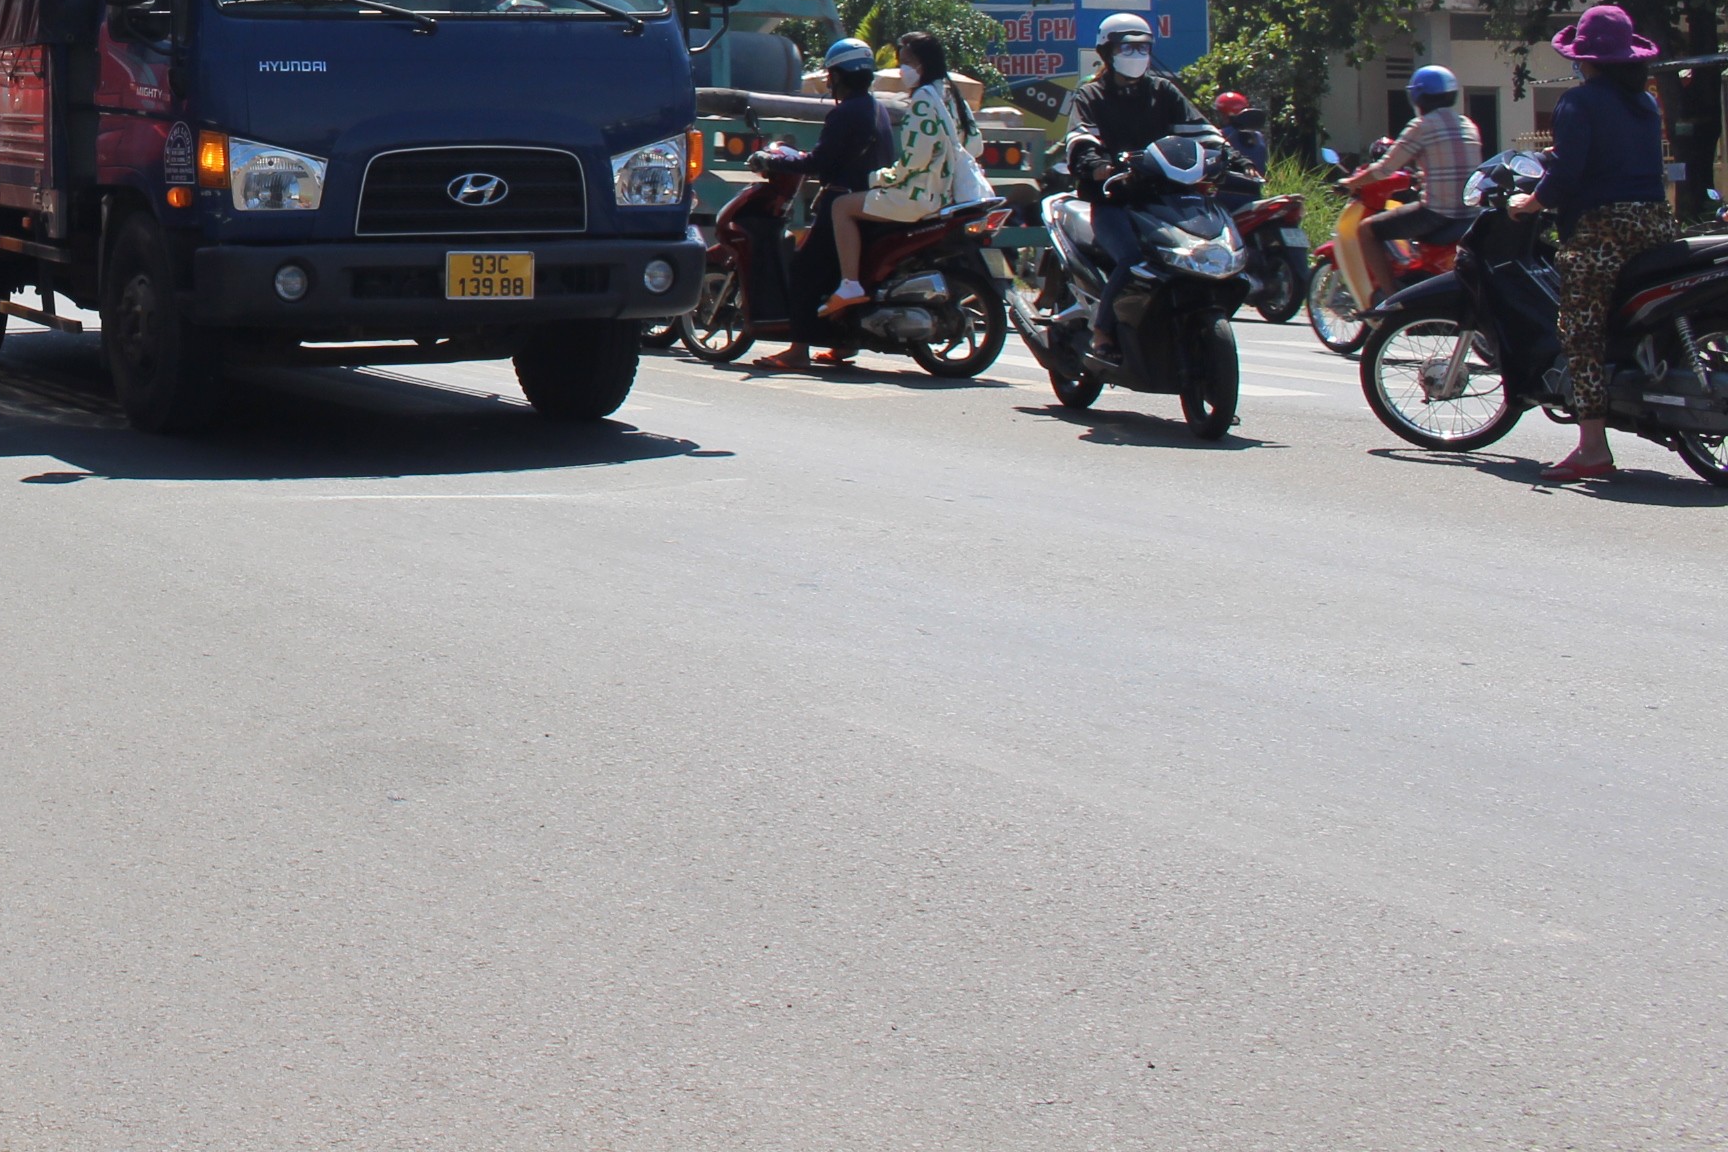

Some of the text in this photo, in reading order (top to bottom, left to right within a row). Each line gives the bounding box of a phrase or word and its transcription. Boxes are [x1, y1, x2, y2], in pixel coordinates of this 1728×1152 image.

[259, 61, 326, 72] HYUNDAI
[136, 86, 162, 99] MIGHTY
[472, 255, 509, 274] 93C
[459, 277, 524, 296] 139.88
